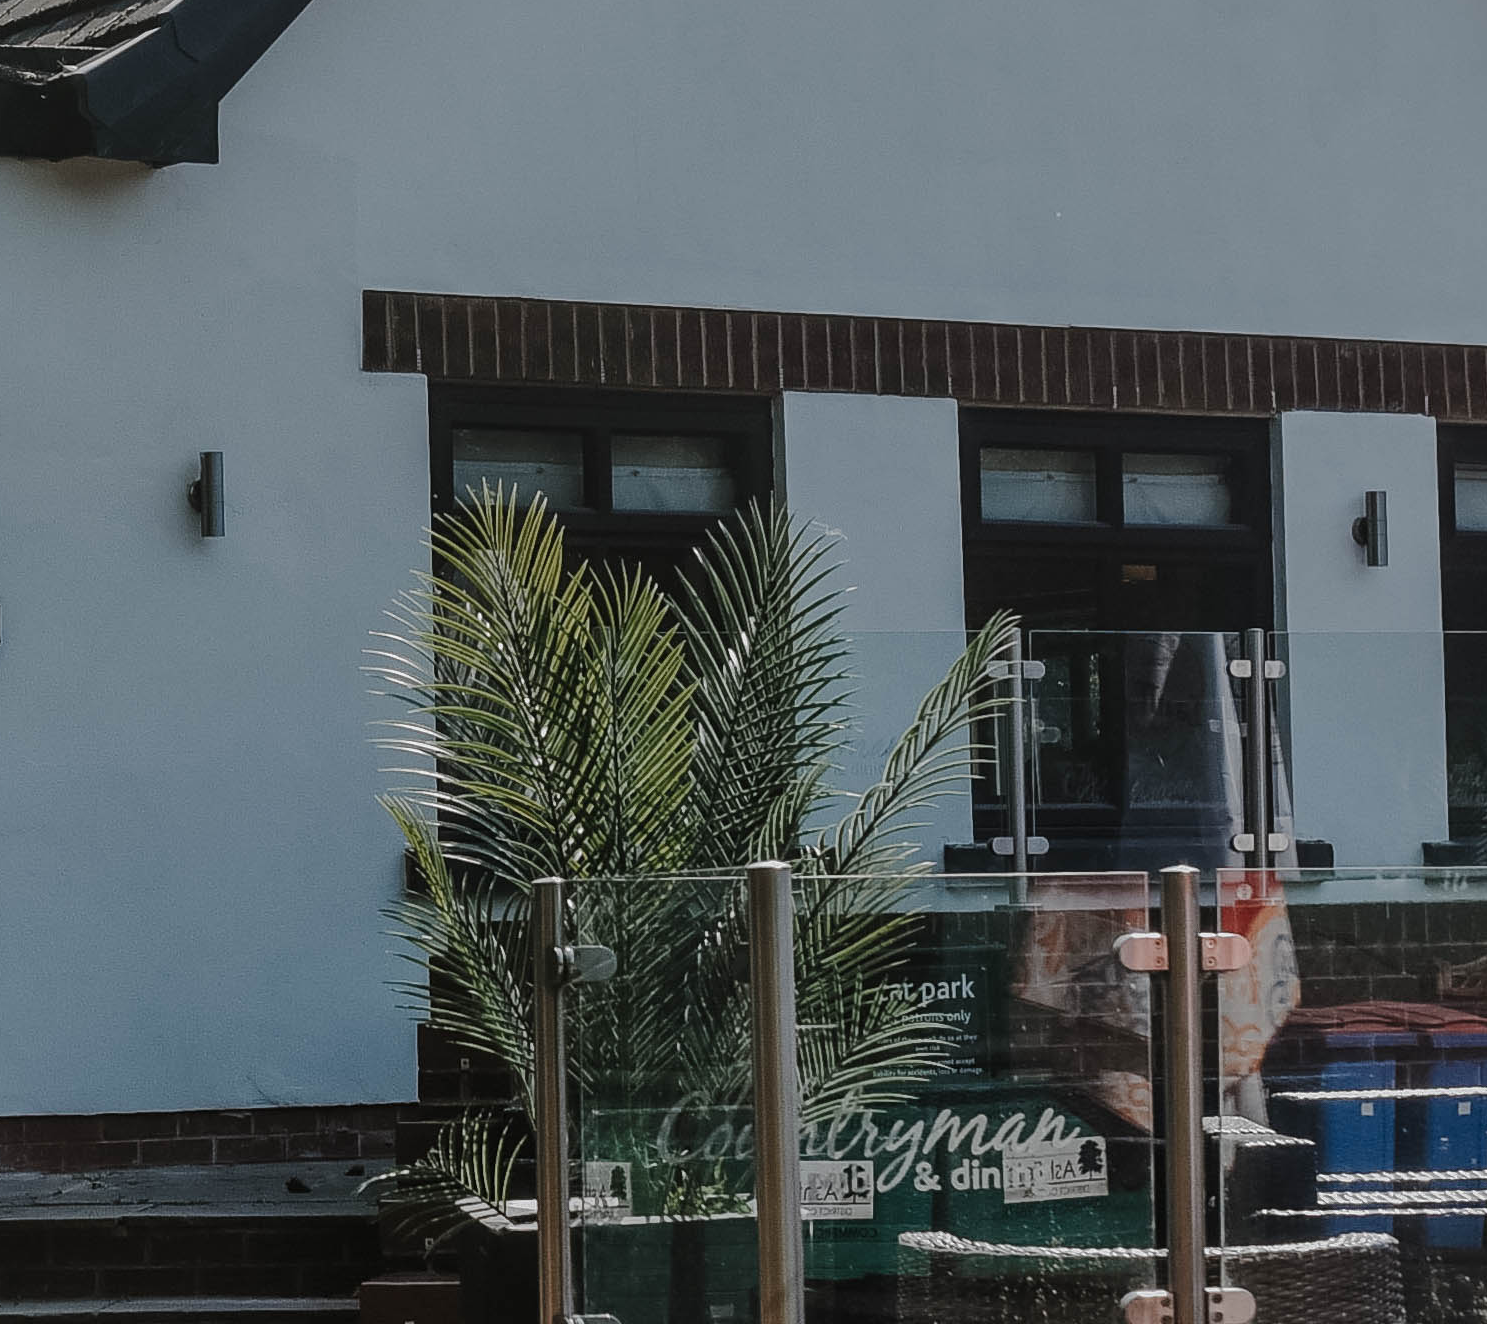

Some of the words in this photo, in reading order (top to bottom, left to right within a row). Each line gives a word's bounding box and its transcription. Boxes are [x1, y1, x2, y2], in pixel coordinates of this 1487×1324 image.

[919, 973, 976, 1008] park
[946, 1009, 972, 1025] only
[913, 1160, 942, 1193] &
